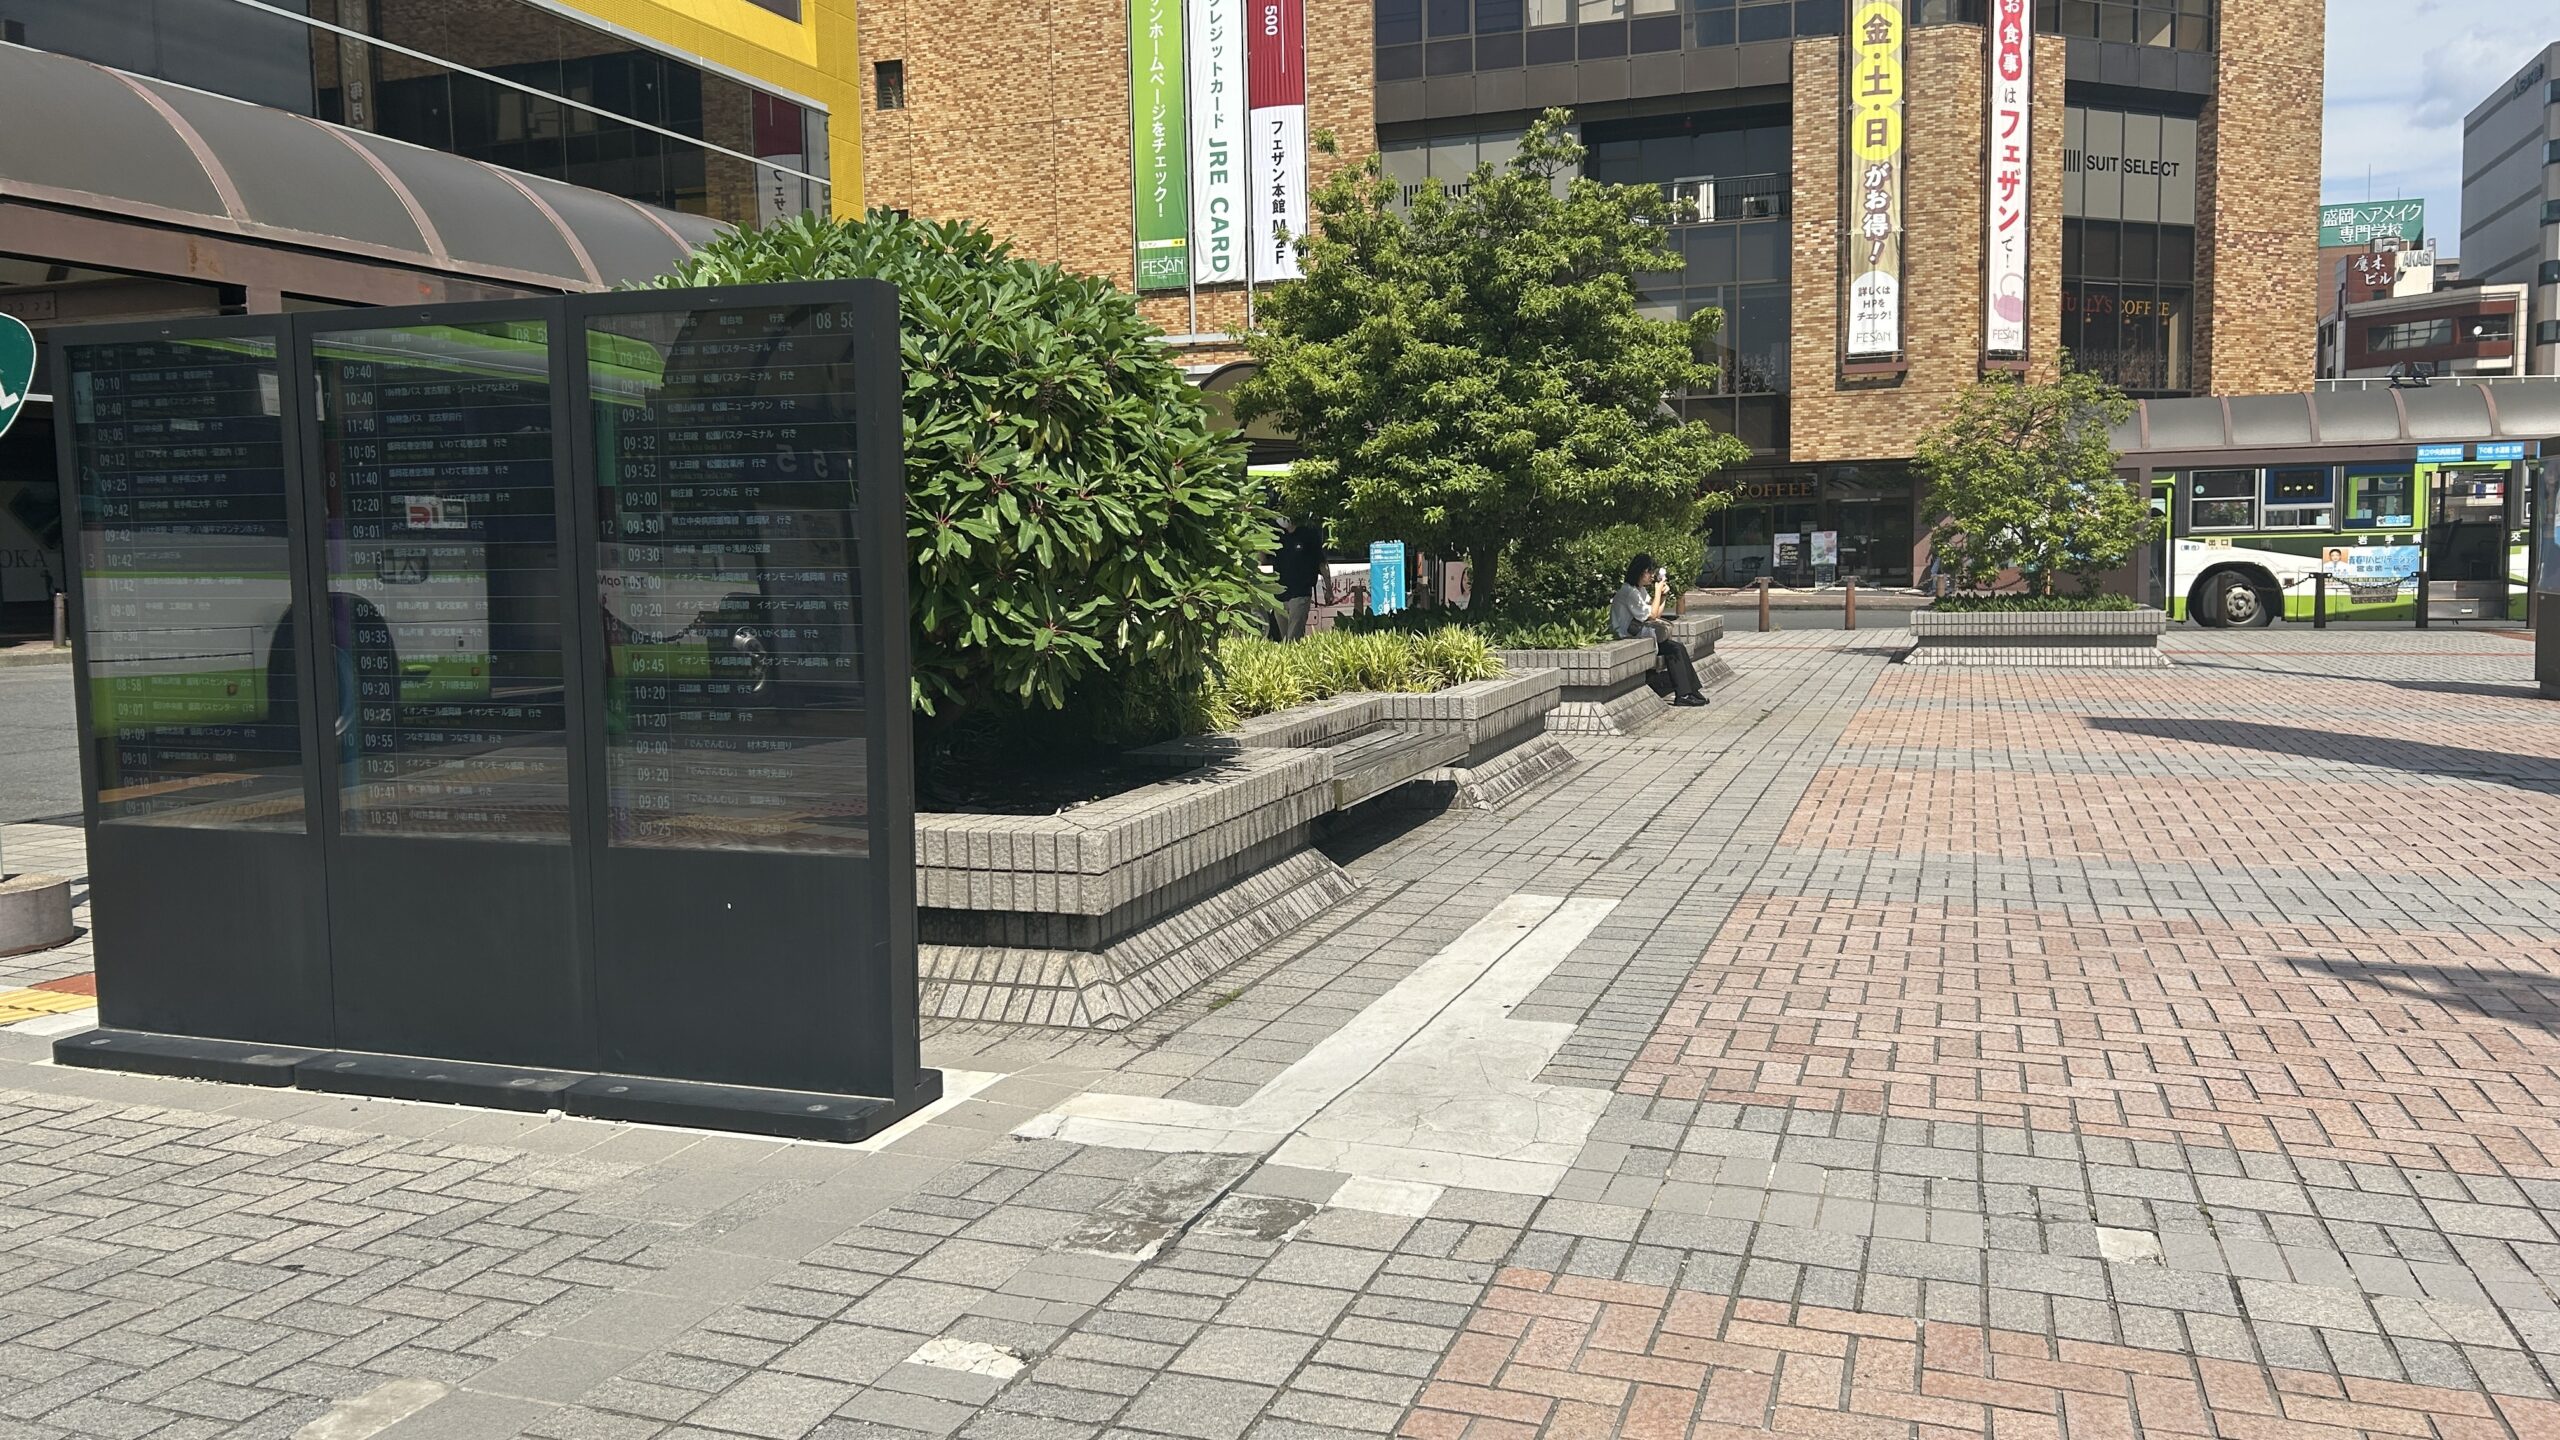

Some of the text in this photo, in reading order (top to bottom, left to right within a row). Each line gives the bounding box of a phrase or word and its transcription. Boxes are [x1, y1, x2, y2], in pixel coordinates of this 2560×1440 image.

[1264, 5, 1278, 36] 500
[1148, 0, 1167, 218] ンホームページをチェック！
[1208, 138, 1227, 186] JRE
[2086, 154, 2180, 177] SUIT SELECT
[2321, 204, 2422, 228] 盛岡ヘアメイク
[1209, 196, 1230, 273] CARD
[2339, 223, 2404, 244] 専門学校
[2364, 273, 2392, 286] ビル
[2120, 299, 2170, 316] COFFEE
[816, 312, 831, 329] 08
[702, 343, 771, 354] 松園バスターミナル
[778, 342, 794, 352] 行き
[343, 364, 372, 379] 09:40
[703, 371, 795, 383] 松園バスターミナル 行き
[93, 377, 120, 391] 09:10
[345, 391, 373, 406] 10:40
[95, 403, 121, 417] 09:40
[622, 400, 796, 422] 09:30 松園ニュータウン 行き
[347, 418, 375, 433] 11:40
[97, 428, 123, 442] 09:05
[623, 428, 797, 450] 09:32 松園バスターミナル 行き
[348, 445, 377, 459] 10:05
[494, 438, 508, 448] 行き
[99, 453, 126, 467] 09:12
[82, 466, 89, 481] 2
[349, 472, 378, 486] 11:40
[494, 465, 509, 475] 行き
[624, 458, 768, 478] 09:52 行き
[101, 473, 228, 492] 09:25 行き
[329, 471, 337, 488] 8
[351, 492, 510, 512] 12:20 行き
[626, 487, 761, 507] 09:00 つつじが丘 行き
[103, 499, 229, 517] 09:42 行き
[352, 524, 380, 538] 09:01
[470, 520, 485, 530] 行き
[600, 520, 614, 535] 12
[626, 520, 659, 534] 09:30
[776, 515, 792, 525] 行き
[104, 528, 131, 542] 09:42
[107, 553, 133, 567] 10:42
[354, 551, 382, 565] 09:13
[627, 548, 660, 562] 09:30
[833, 572, 848, 583] 行き
[110, 604, 136, 617] 09:00
[357, 604, 386, 617] 09:30
[630, 603, 662, 617] 09:20
[833, 600, 849, 610] 行き
[359, 630, 387, 643] 09:35
[803, 629, 819, 639] 行き
[360, 656, 388, 670] 09:05
[633, 658, 665, 673] 09:45
[835, 657, 851, 668] 行き
[362, 682, 390, 696] 09:20
[635, 684, 752, 700] 10:20 行き
[118, 703, 143, 716] 09:07
[363, 707, 392, 721] 09:25
[528, 708, 542, 718] 行き
[635, 711, 753, 727] 11:20 行き
[120, 728, 145, 741] 09:09
[244, 728, 257, 738] 行き
[343, 733, 354, 746] 10
[365, 733, 393, 747] 09:55
[637, 740, 668, 755] 09:00
[122, 752, 147, 765] 09:10
[367, 759, 394, 773] 10:25
[638, 767, 669, 782] 09:20
[368, 784, 396, 798] 10:41
[126, 800, 151, 814] 09:10
[639, 794, 670, 809] 09:05
[370, 811, 507, 824] 10:50 行き
[640, 821, 671, 836] 09:25
